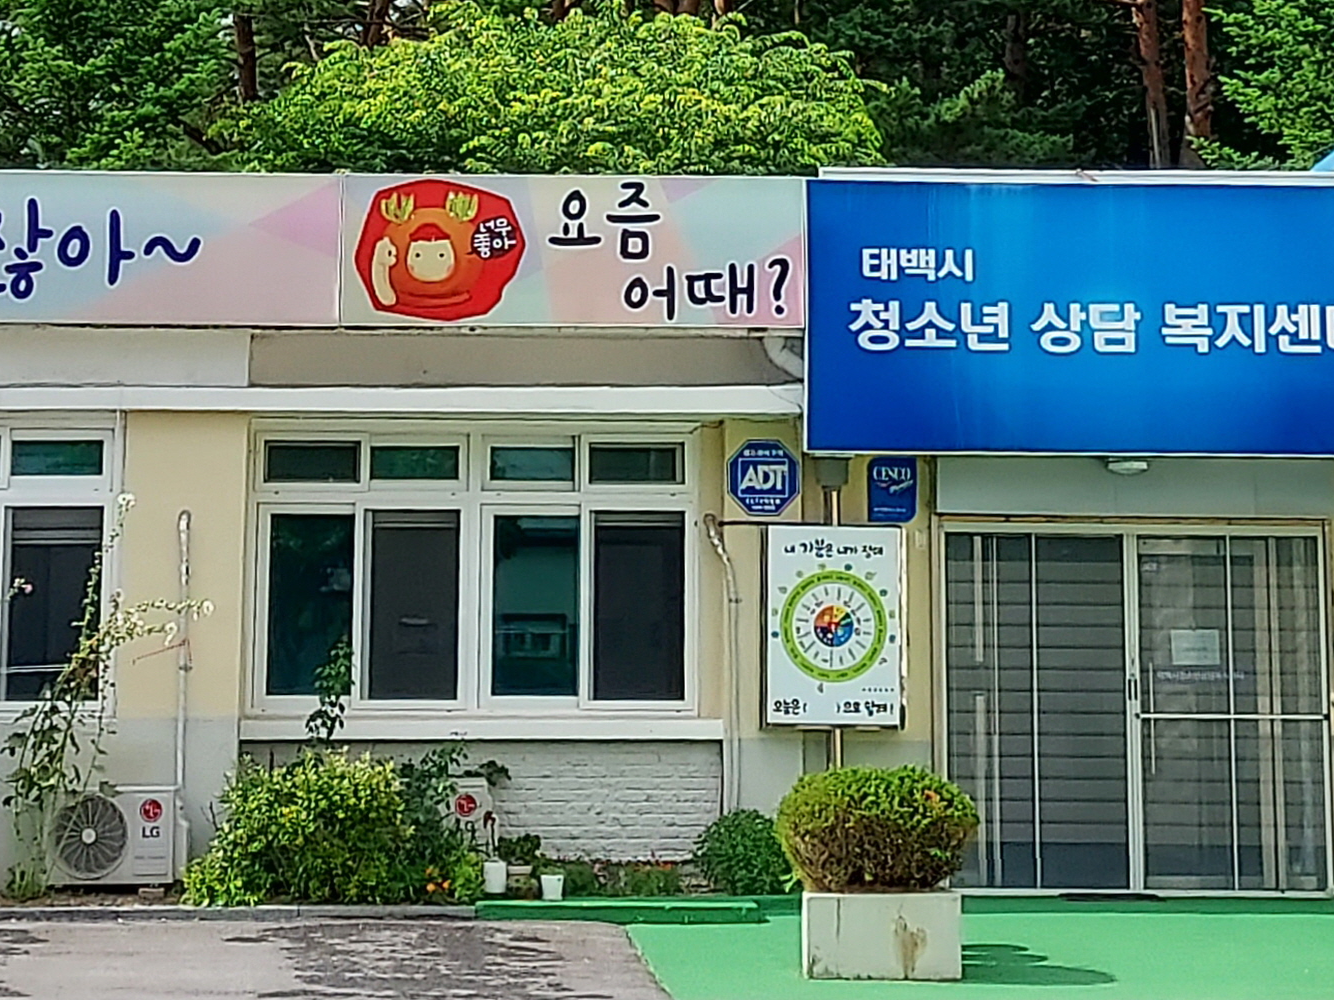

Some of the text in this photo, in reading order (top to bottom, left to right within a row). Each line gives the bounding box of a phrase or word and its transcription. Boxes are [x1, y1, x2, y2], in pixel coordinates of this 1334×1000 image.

[548, 181, 661, 260] 요즘
[861, 248, 974, 282] 태백시
[620, 256, 790, 321] 어때?
[848, 300, 1010, 352] 청소년
[1030, 303, 1142, 353] 상담
[740, 465, 787, 490] ADT
[142, 826, 160, 839] LG
